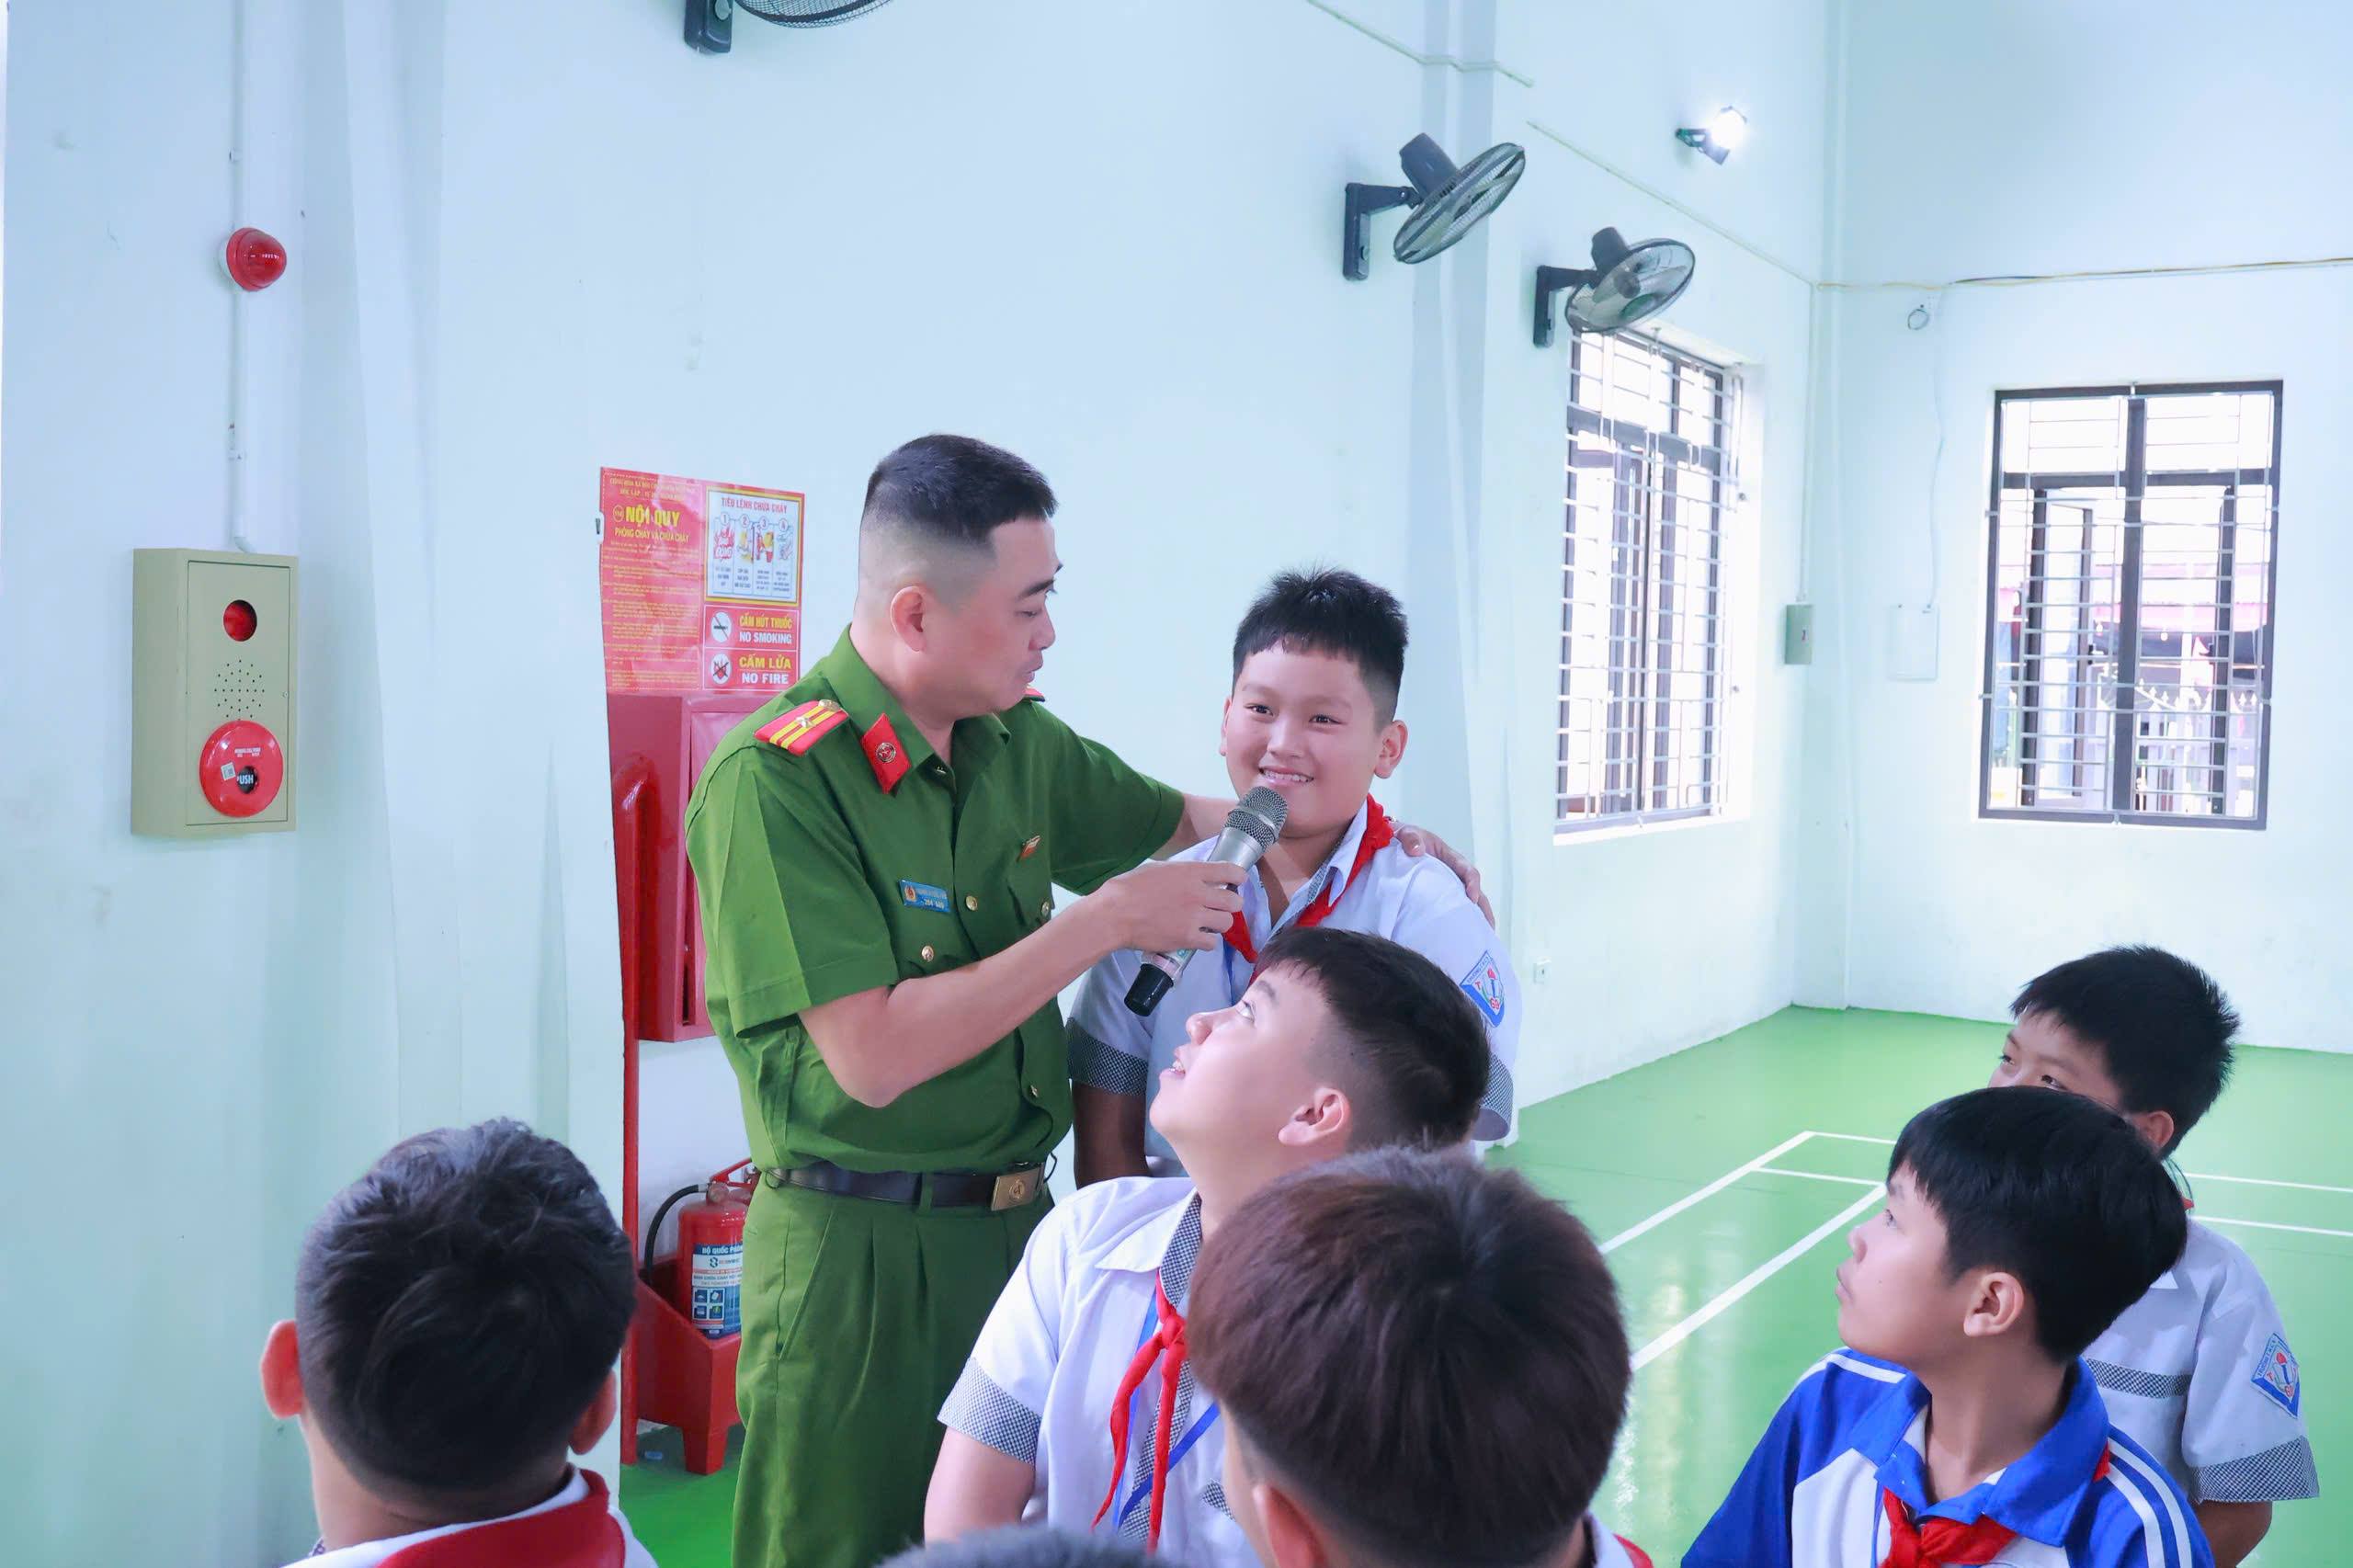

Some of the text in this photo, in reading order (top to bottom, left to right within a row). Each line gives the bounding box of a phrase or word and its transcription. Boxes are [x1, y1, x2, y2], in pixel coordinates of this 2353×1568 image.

[625, 504, 651, 527] NỘI
[654, 508, 680, 527] QUY
[739, 611, 793, 629] CẤM HÚT THUỐC
[739, 631, 792, 644] NO SMOKING
[738, 653, 791, 670] CẤM LỬA
[741, 672, 790, 685] NO FIRE
